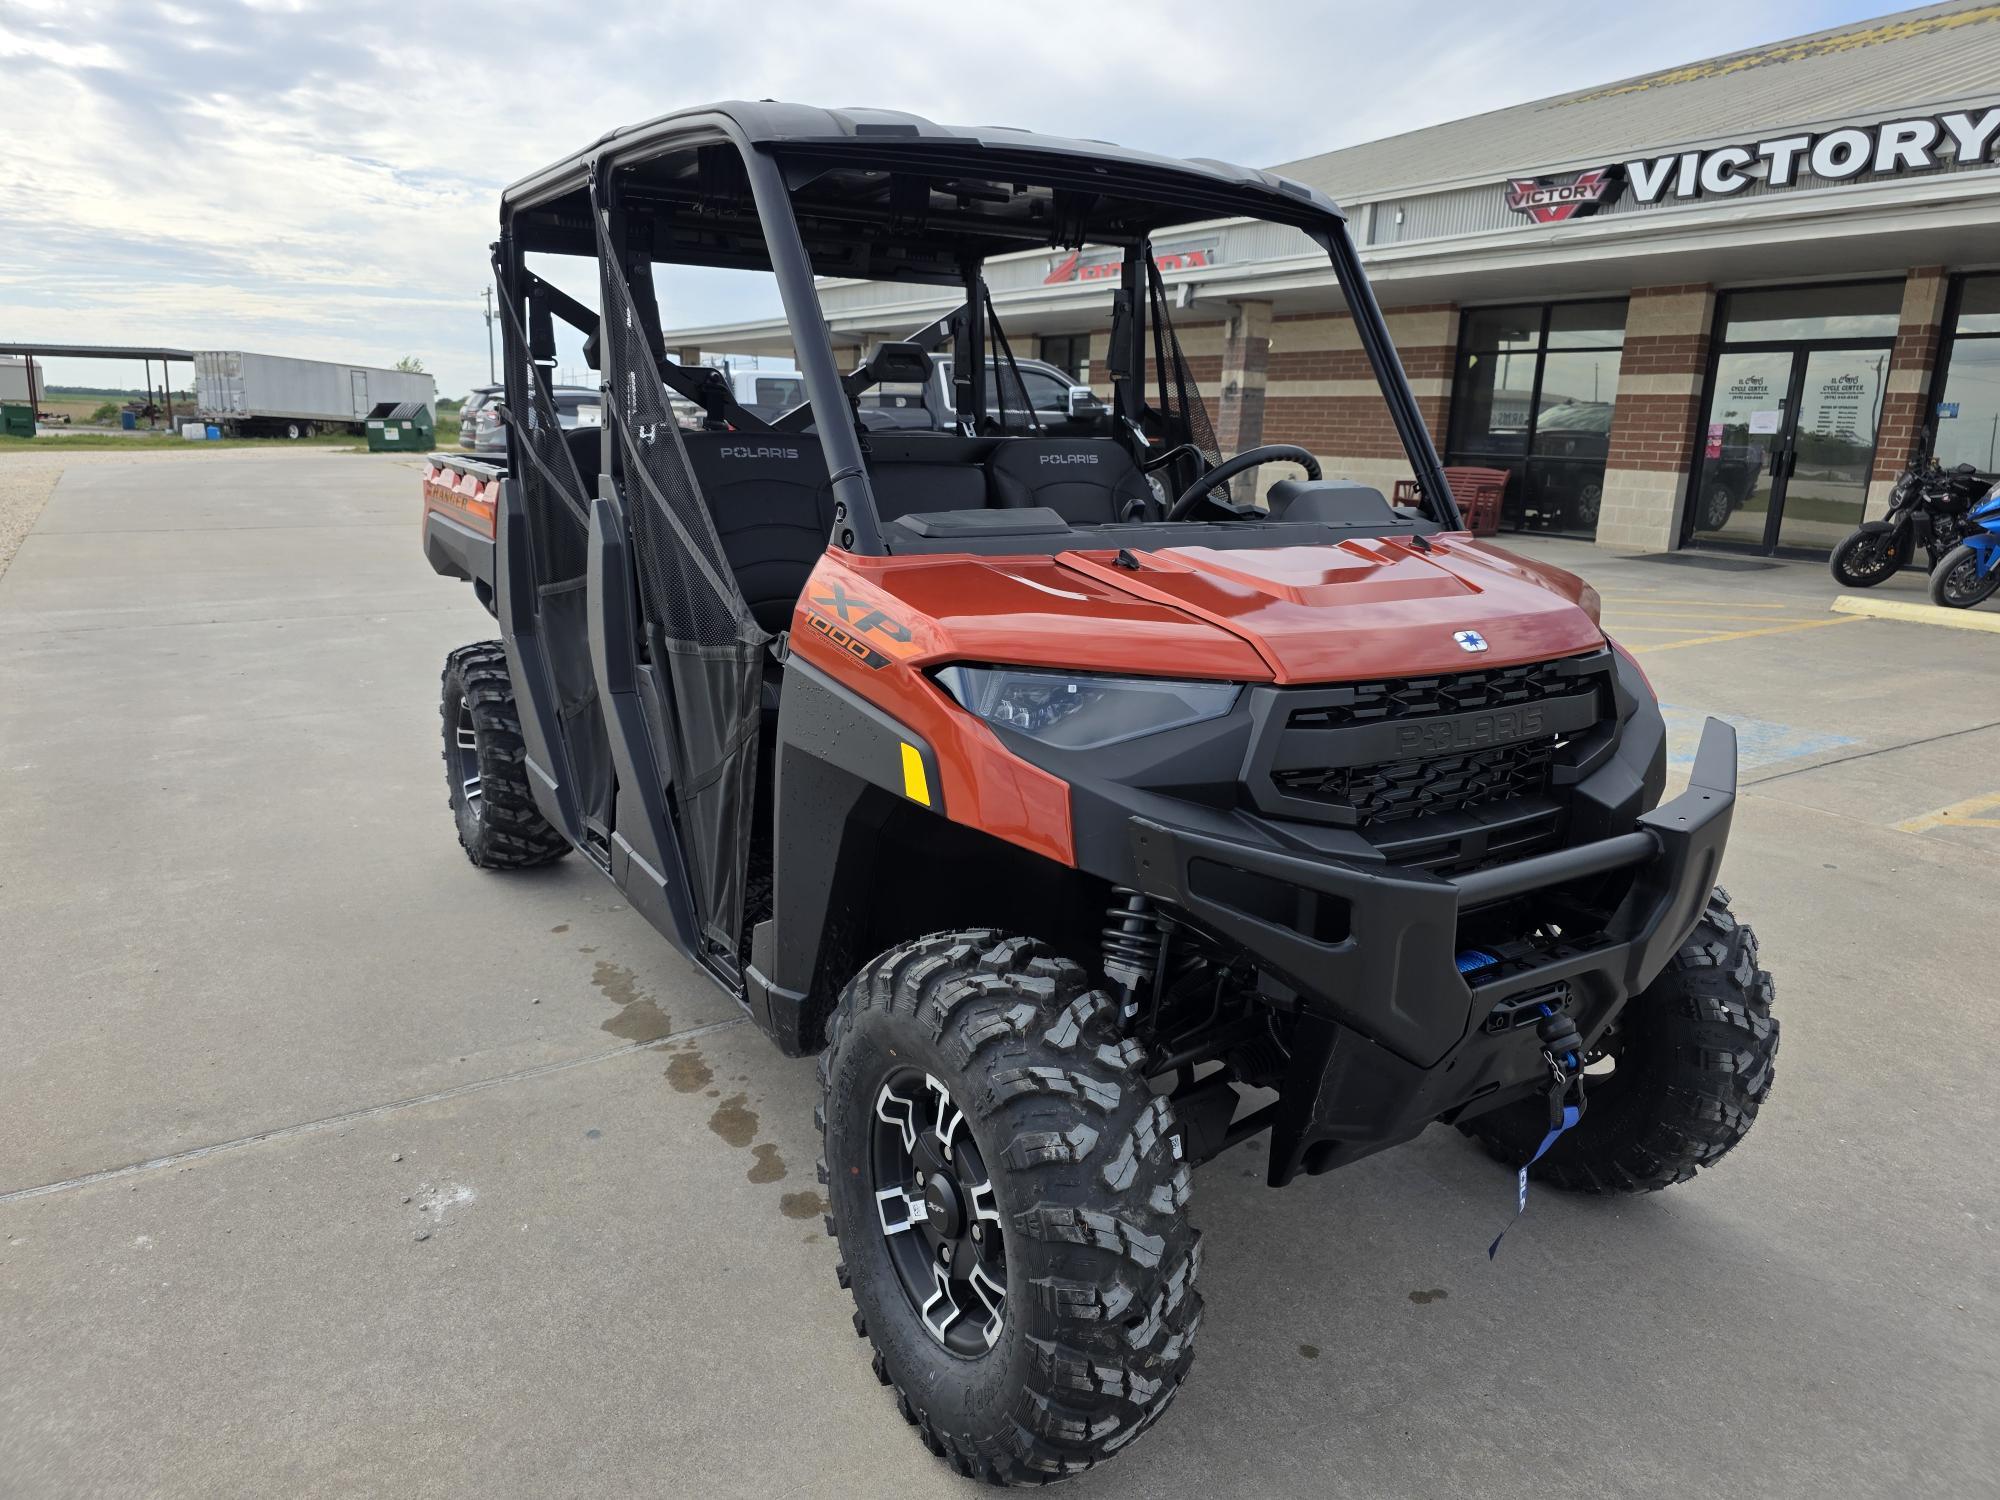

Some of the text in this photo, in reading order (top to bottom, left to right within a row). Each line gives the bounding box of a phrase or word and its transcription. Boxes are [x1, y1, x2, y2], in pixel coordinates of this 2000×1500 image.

[1624, 108, 2000, 202] VICTORY
[1511, 184, 1602, 206] VICTORY
[720, 447, 799, 458] POLARIS
[1039, 454, 1099, 464] POLARIS
[431, 484, 468, 512] RANGER
[811, 580, 912, 643] XP
[804, 608, 871, 660] 1000
[1396, 705, 1545, 755] POLARIS
[927, 1201, 945, 1213] XP
